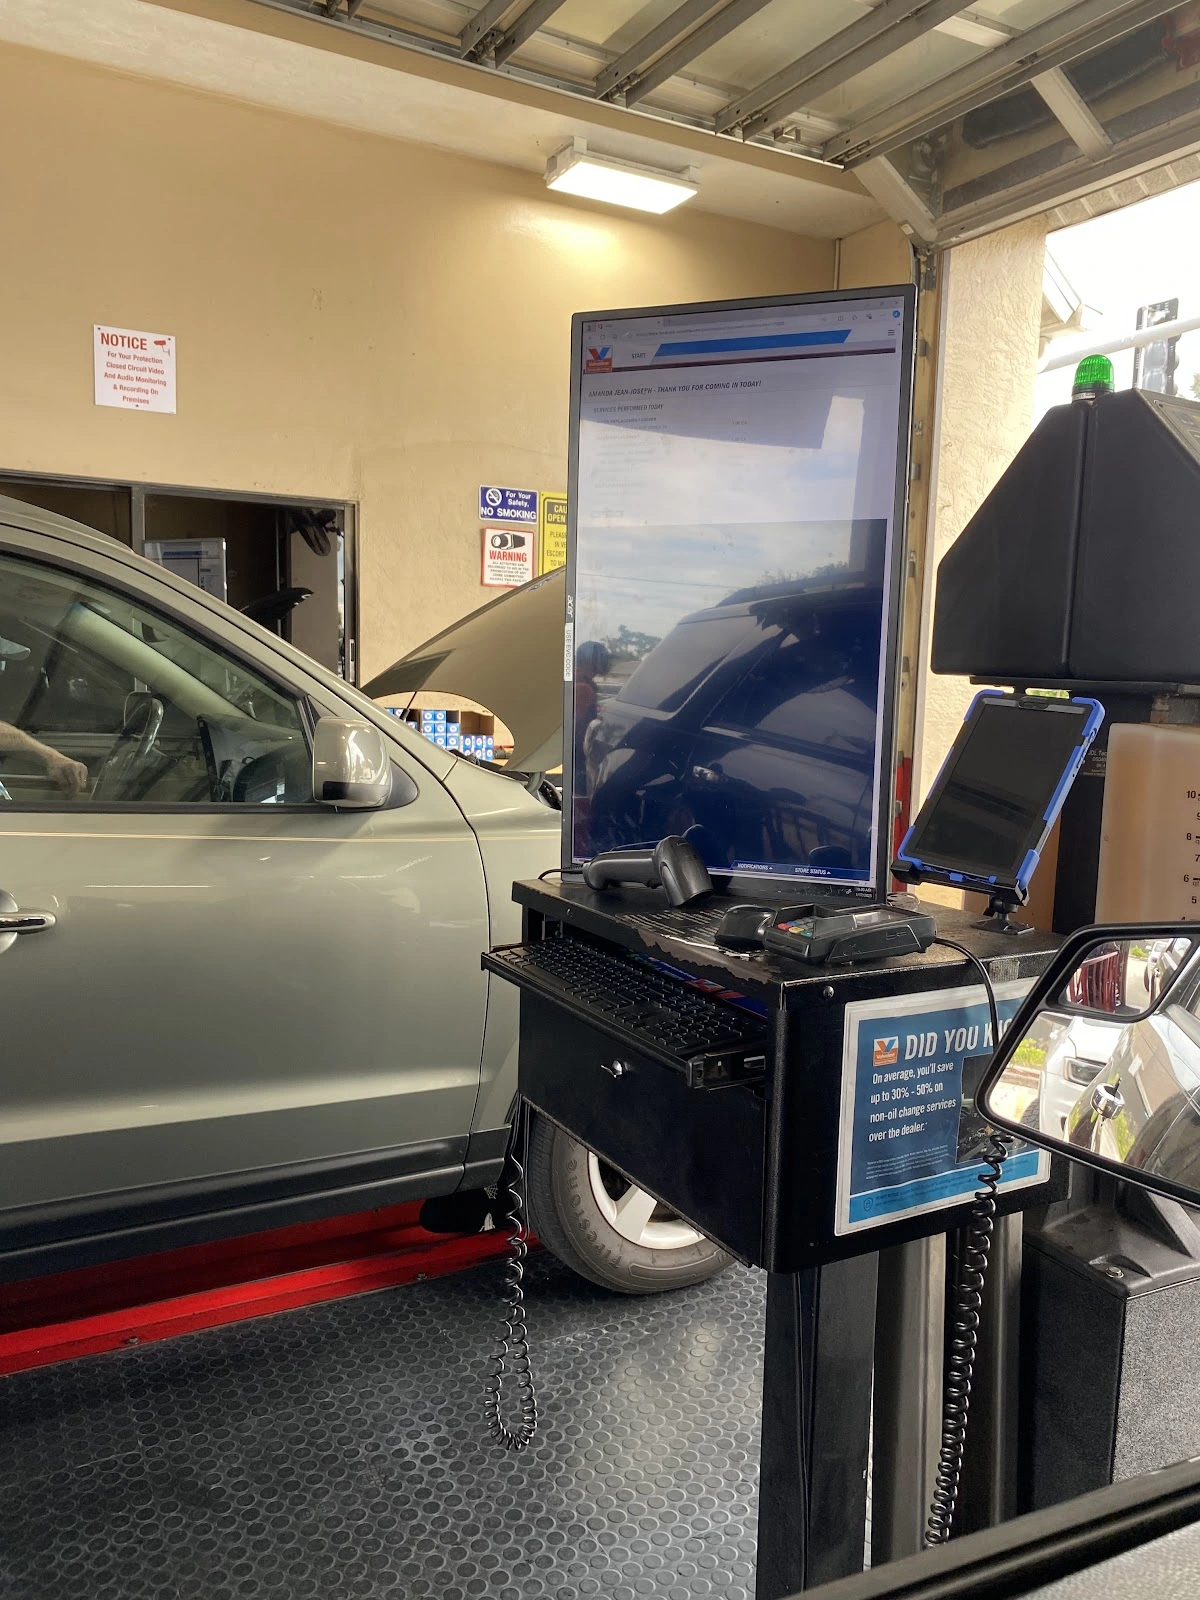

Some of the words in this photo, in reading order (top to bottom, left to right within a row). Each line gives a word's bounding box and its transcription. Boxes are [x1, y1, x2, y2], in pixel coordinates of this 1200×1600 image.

[101, 332, 147, 350] NOTICE
[119, 352, 131, 360] Your
[133, 354, 163, 364] Protection
[106, 362, 126, 370] Closed
[128, 364, 147, 372] Circuit
[148, 366, 164, 375] Video
[117, 374, 134, 382] Audio
[136, 376, 166, 386] Monitoring
[120, 384, 149, 395] Recording
[614, 388, 652, 396] JEAN-JOSEPH
[705, 382, 730, 390] COMING
[740, 380, 762, 388] TODAY!
[123, 395, 149, 404] Premises
[518, 492, 531, 500] Your
[481, 507, 494, 516] NO
[497, 508, 536, 519] SMOKING
[554, 505, 567, 513] CAU
[548, 514, 566, 522] OPEN
[490, 550, 527, 562] WARNING
[1186, 790, 1196, 799] 10
[1186, 832, 1192, 840] 8
[1195, 854, 1200, 862] 7
[1184, 874, 1189, 882] 6
[1192, 896, 1197, 904] 5
[905, 1032, 938, 1060] DID
[944, 1026, 978, 1054] YOU
[873, 1074, 882, 1084] On
[884, 1069, 915, 1080] average,
[917, 1063, 935, 1079] you'll
[937, 1062, 953, 1072] save
[871, 1094, 880, 1105] up
[882, 1091, 889, 1102] to
[892, 1087, 909, 1100] 30%
[916, 1082, 933, 1096] 50%
[935, 1083, 943, 1092] on
[870, 1108, 897, 1123] non-oil
[899, 1104, 925, 1118] change
[927, 1099, 956, 1112] services
[869, 1131, 886, 1142] over
[888, 1128, 900, 1138] the
